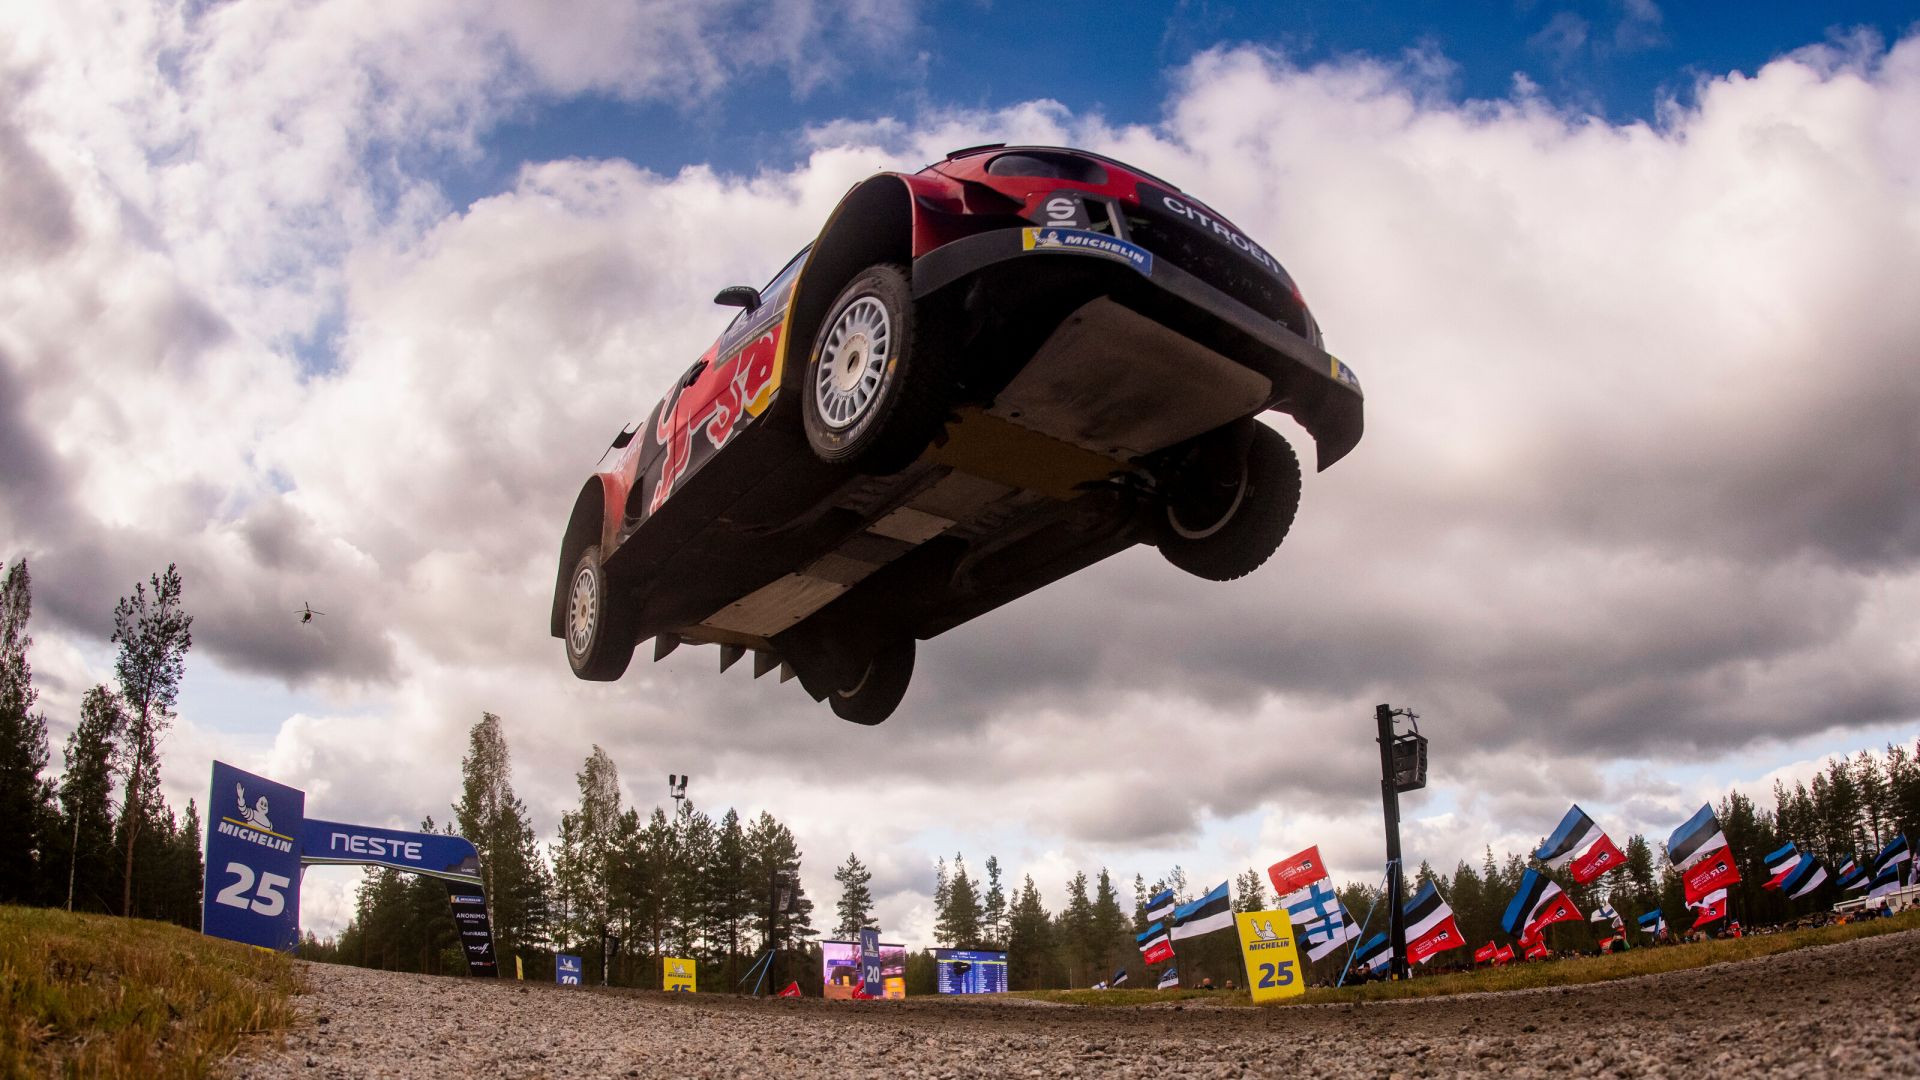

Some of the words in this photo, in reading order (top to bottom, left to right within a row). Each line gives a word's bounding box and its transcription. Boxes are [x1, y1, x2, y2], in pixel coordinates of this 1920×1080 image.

[1065, 235, 1144, 264] MICHELIN
[218, 821, 293, 853] MICHELIN
[330, 832, 422, 860] NESTE
[216, 862, 290, 917] 25
[1249, 940, 1290, 951] MICHELIN
[866, 965, 880, 983] 20
[1258, 960, 1294, 989] 25
